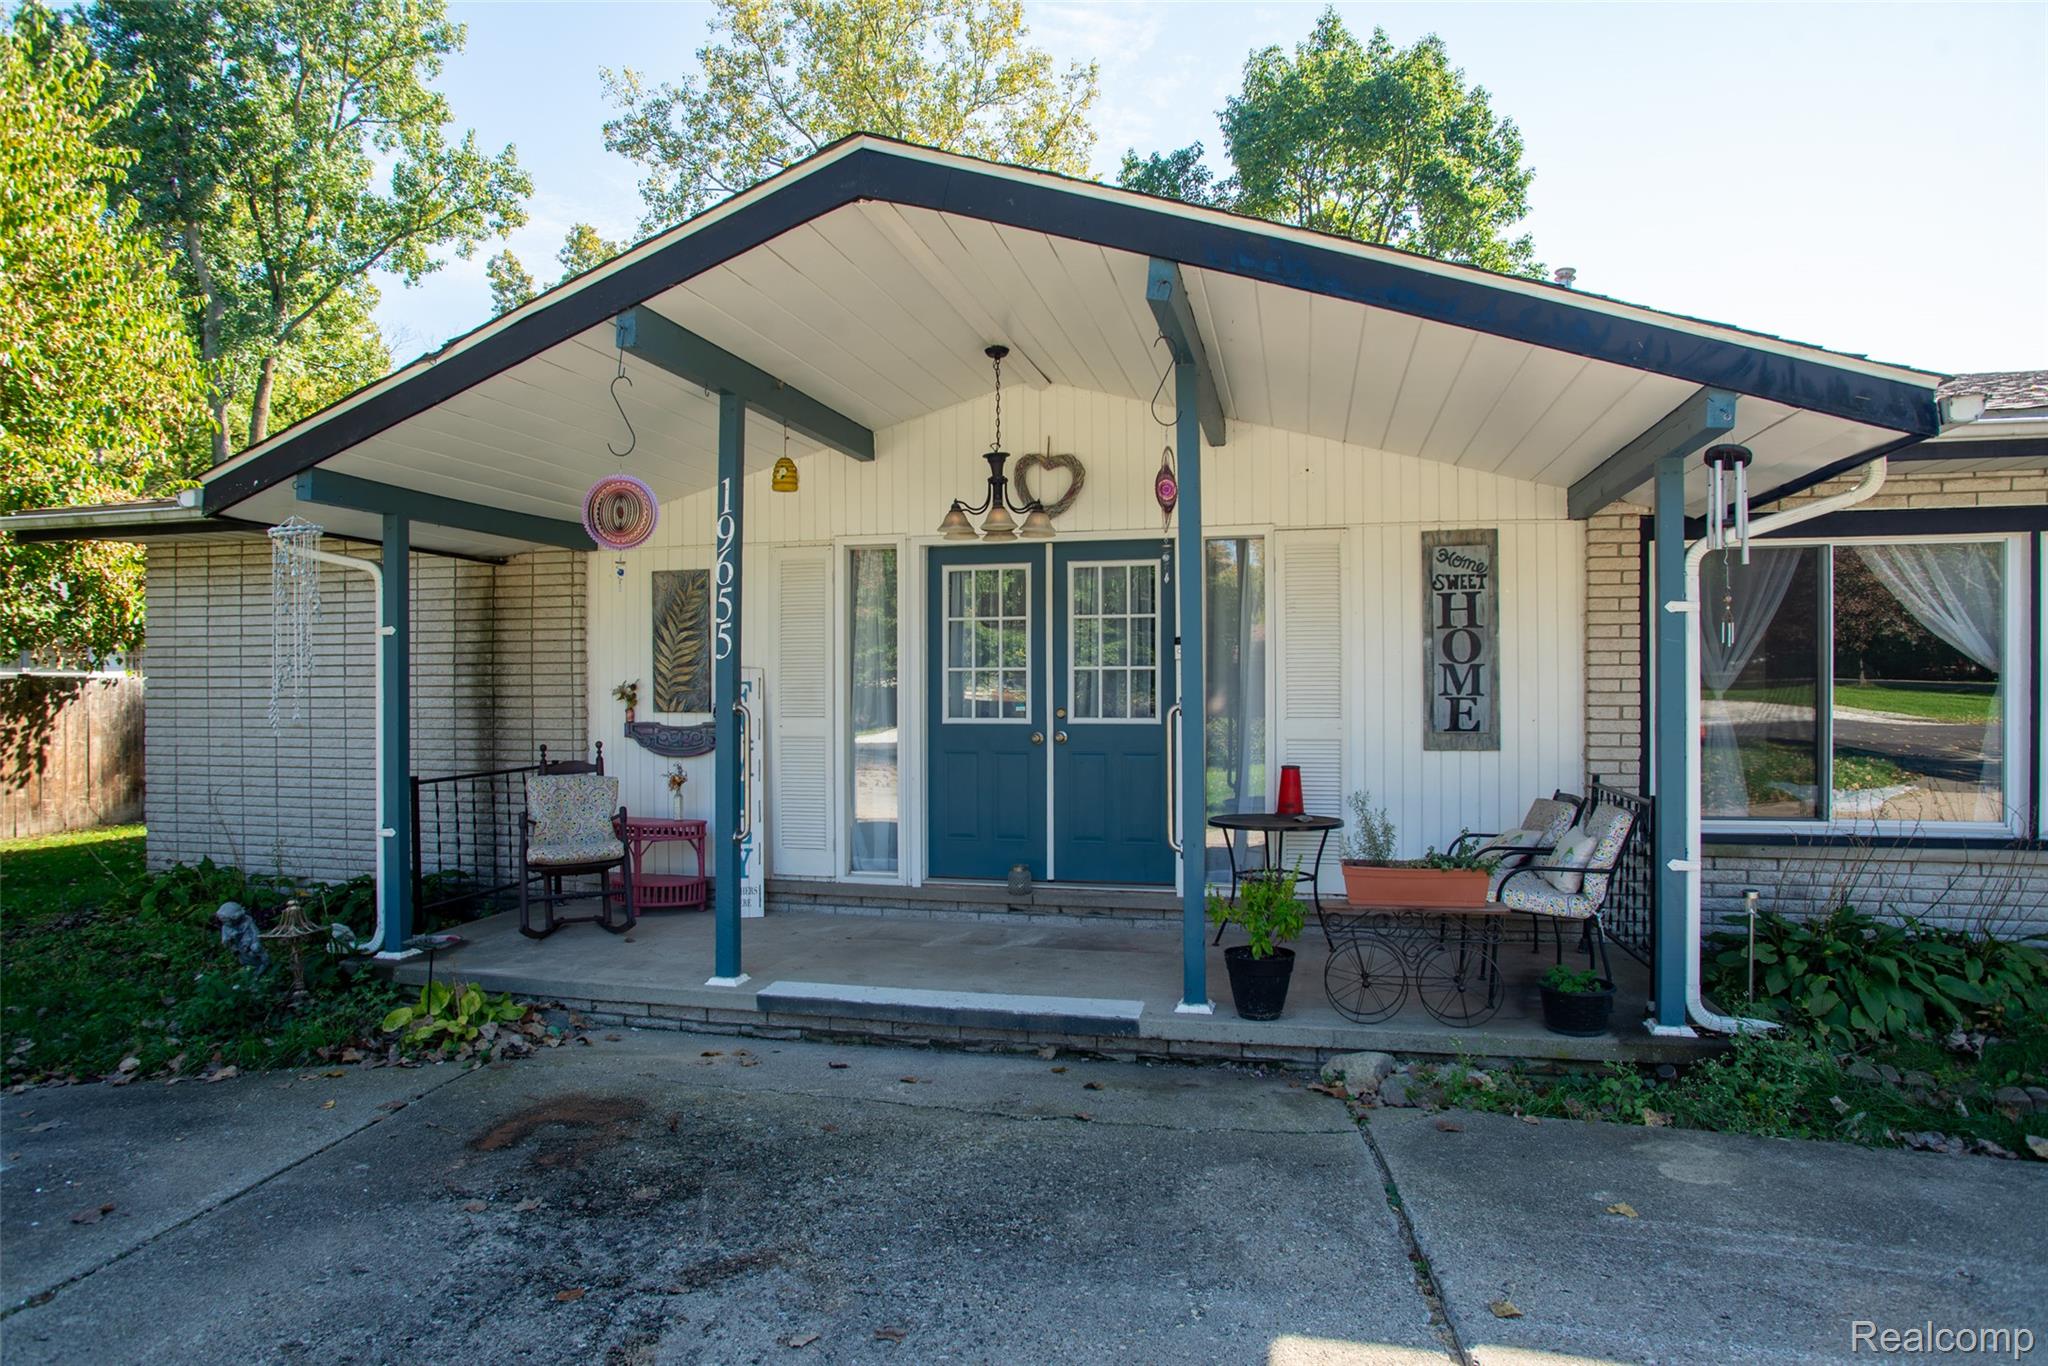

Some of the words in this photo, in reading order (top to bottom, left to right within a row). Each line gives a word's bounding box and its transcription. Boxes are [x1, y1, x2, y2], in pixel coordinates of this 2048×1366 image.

[715, 477, 736, 660] 19655
[1432, 573, 1488, 591] SWEET
[1436, 547, 1488, 573] Home
[1436, 590, 1486, 732] HOME
